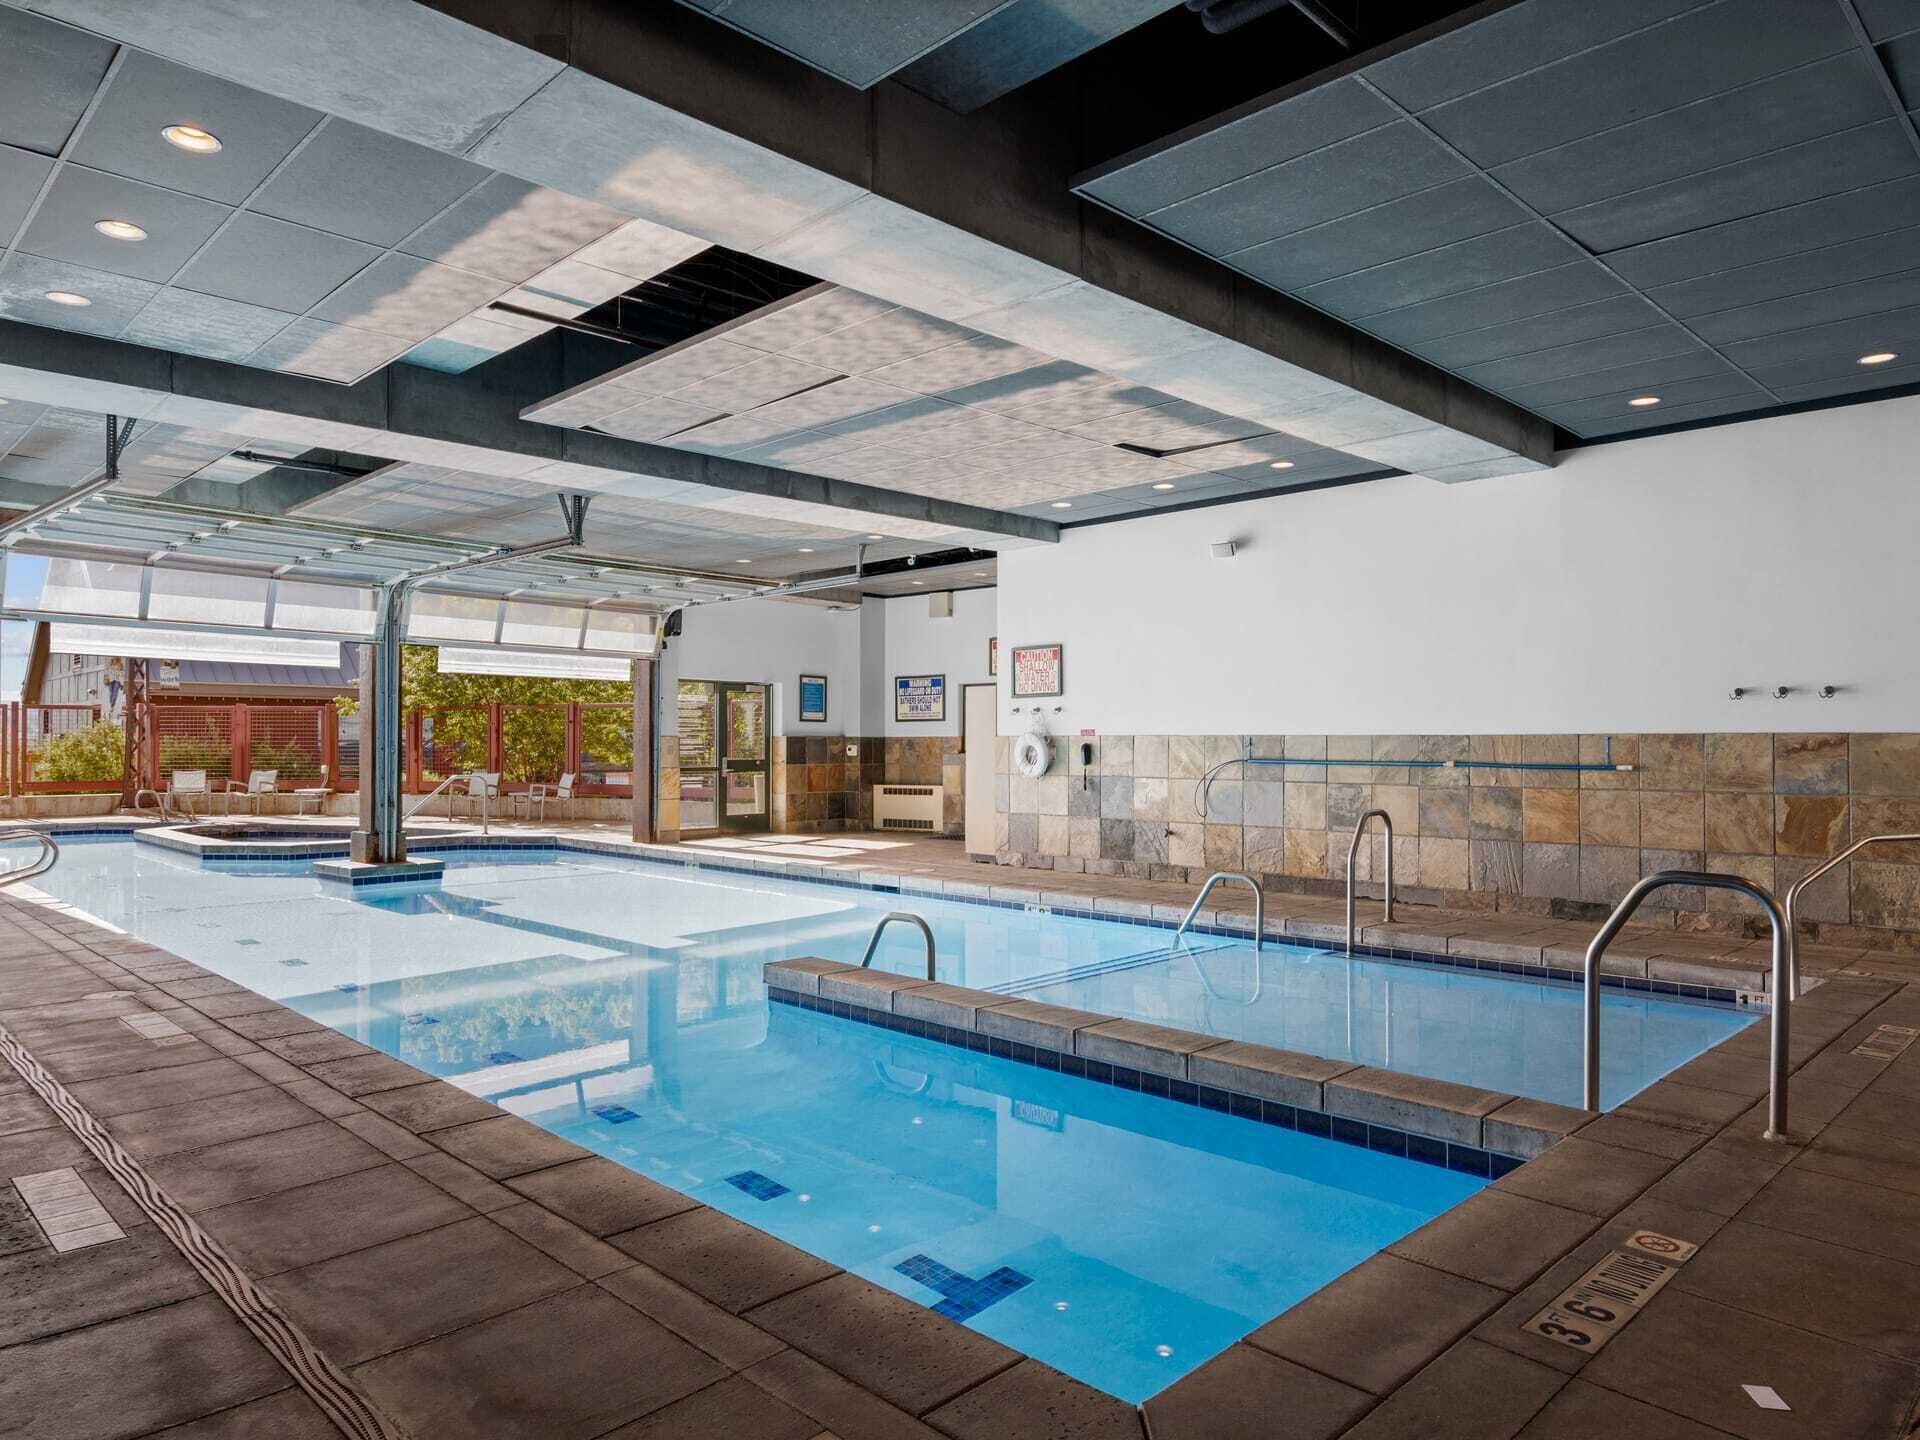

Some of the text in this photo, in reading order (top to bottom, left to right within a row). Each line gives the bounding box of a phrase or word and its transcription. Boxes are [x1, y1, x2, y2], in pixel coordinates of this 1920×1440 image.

[1020, 649, 1053, 662] CAUTION
[1018, 660, 1056, 673] SHALLOW
[1024, 671, 1050, 683] WATER
[1031, 680, 1056, 692] DIVING
[1598, 1254, 1668, 1290] DIVING
[1583, 1279, 1640, 1303] NO
[1563, 1300, 1616, 1322] 6
[1538, 1322, 1591, 1345] 3
